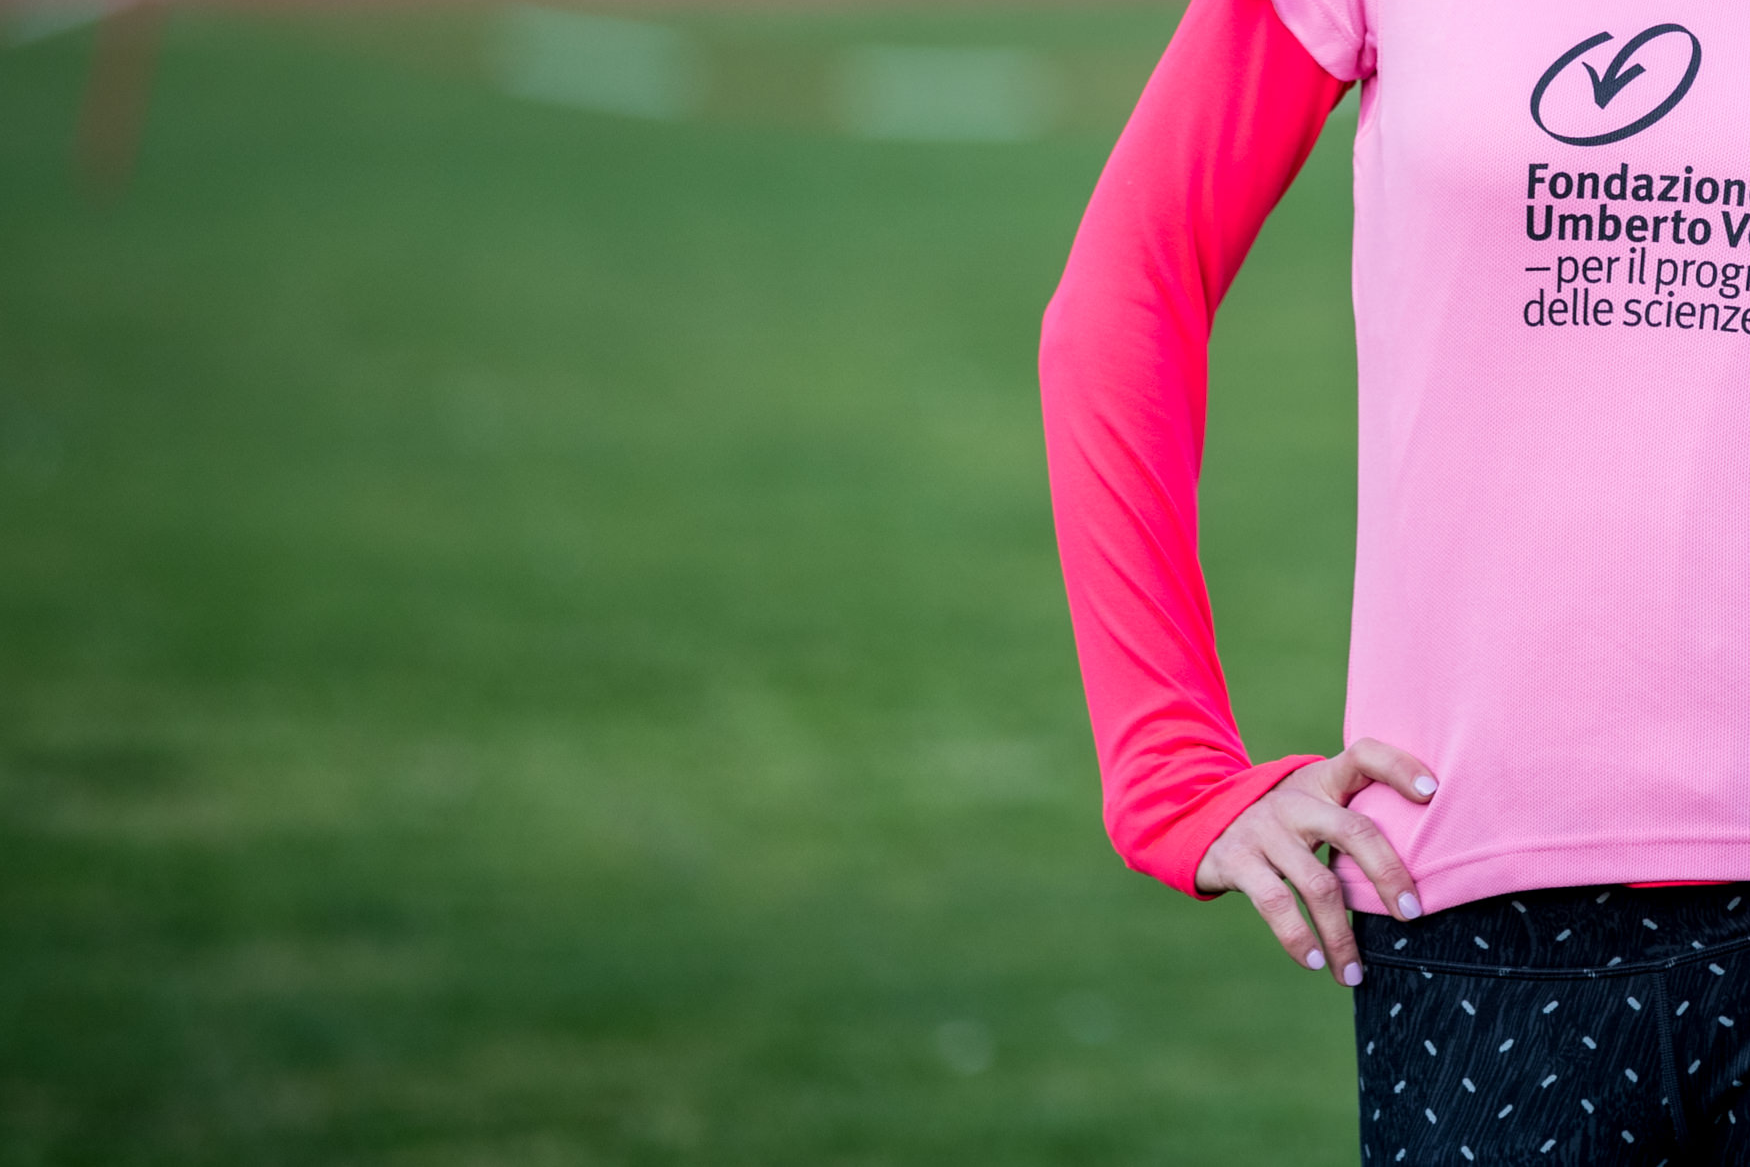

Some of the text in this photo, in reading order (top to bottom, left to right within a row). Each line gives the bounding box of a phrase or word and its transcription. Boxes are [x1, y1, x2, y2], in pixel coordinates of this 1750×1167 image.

[1526, 203, 1712, 246] Umberto
[1628, 246, 1646, 285] il
[1523, 288, 1614, 328] delle
